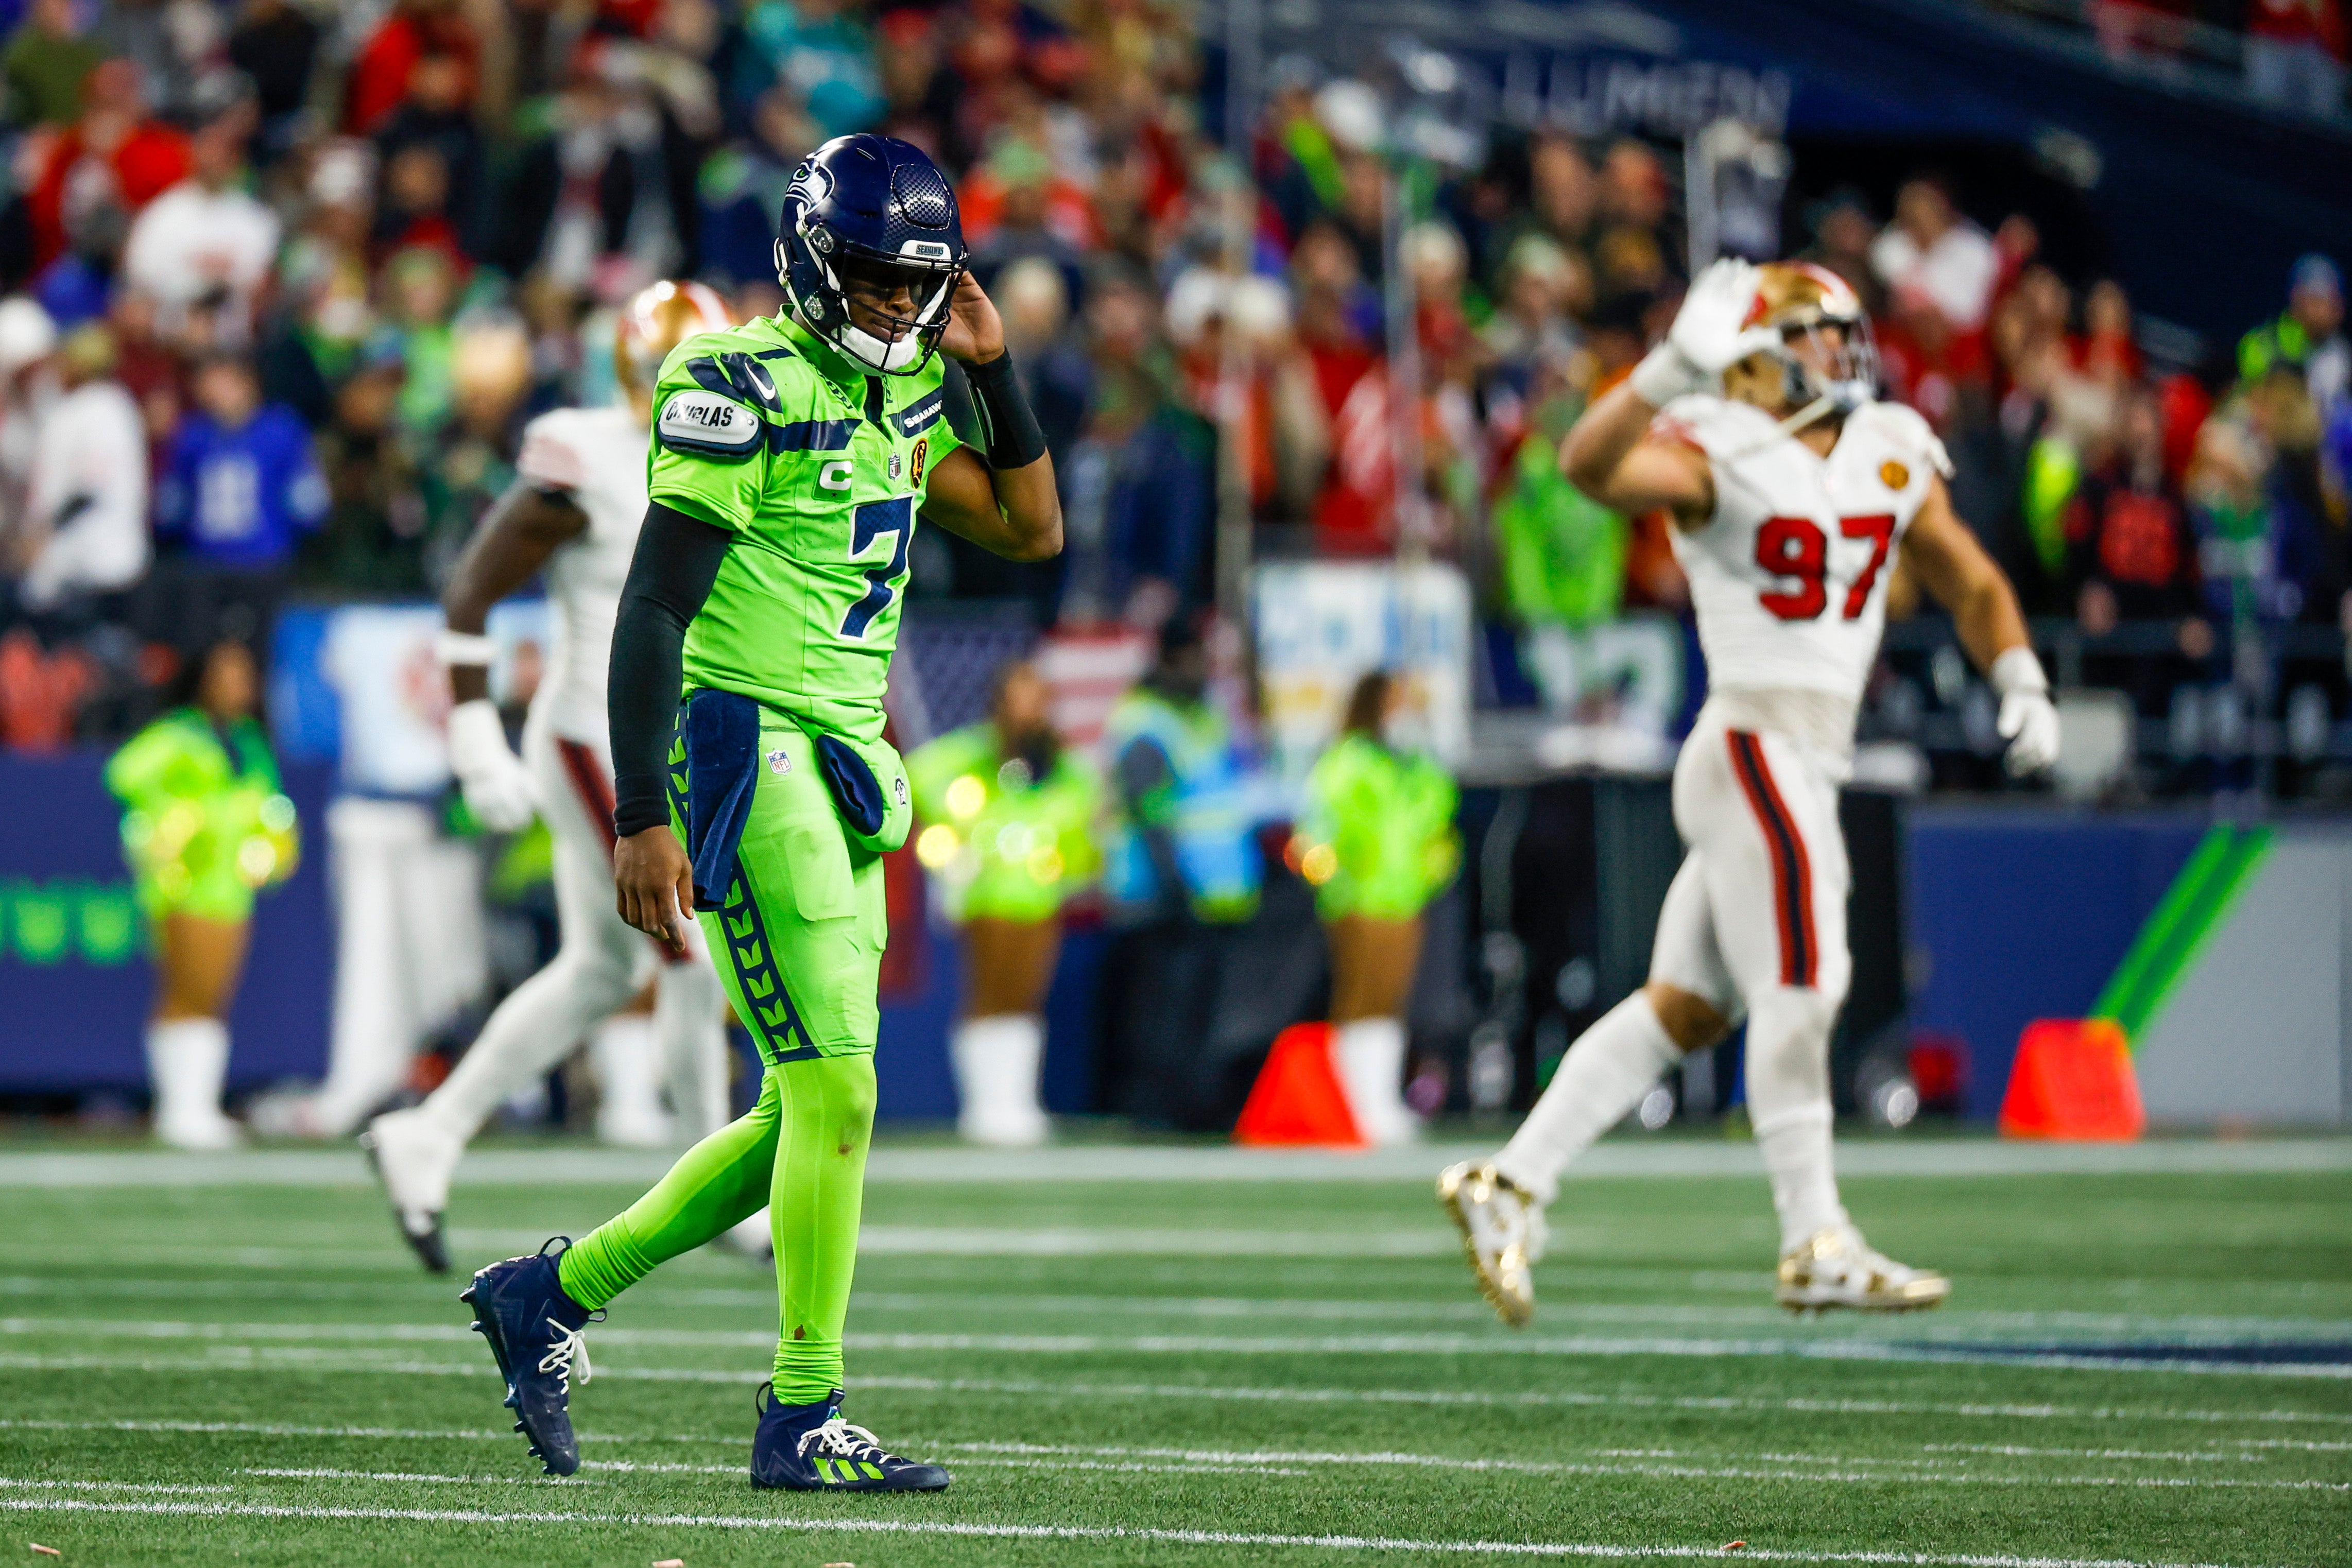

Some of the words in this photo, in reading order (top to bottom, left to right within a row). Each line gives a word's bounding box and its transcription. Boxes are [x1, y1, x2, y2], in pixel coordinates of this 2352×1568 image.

[904, 399, 942, 428] SEAHAW
[819, 460, 853, 491] C
[835, 492, 917, 642] 7
[1755, 514, 1896, 621] 97
[772, 760, 789, 770] NFL
